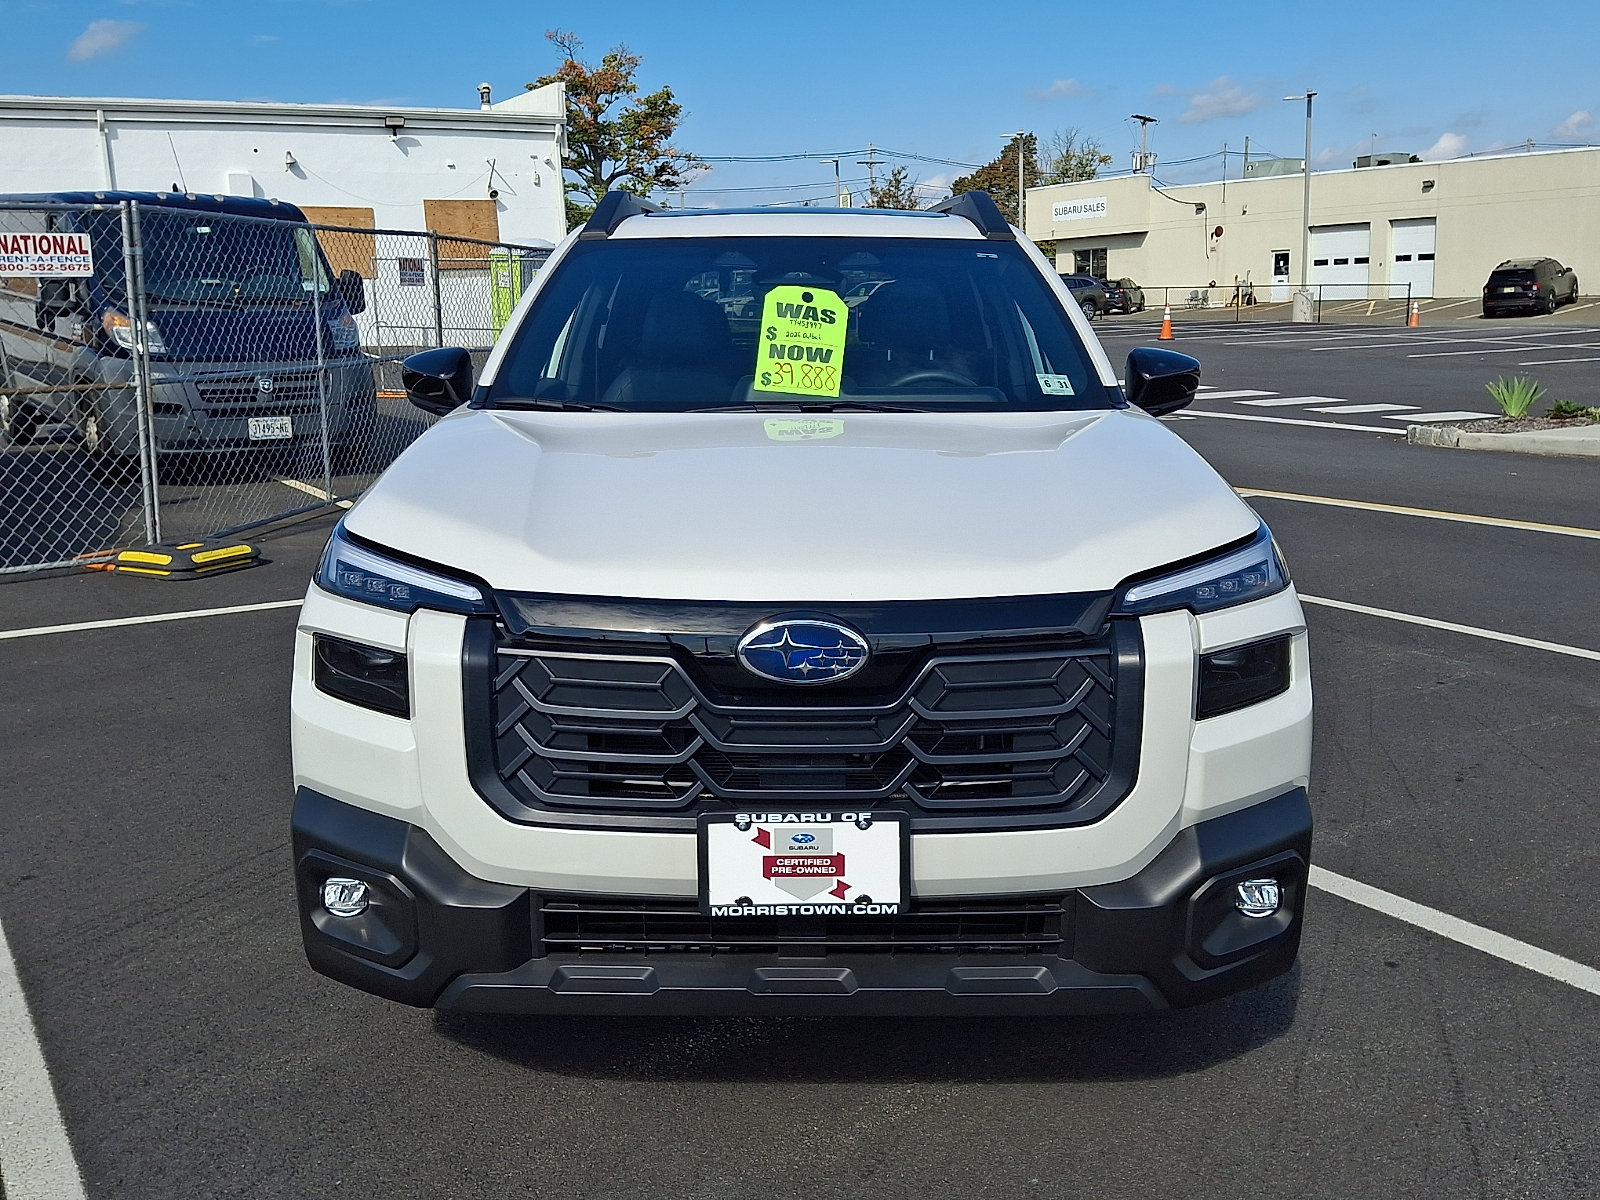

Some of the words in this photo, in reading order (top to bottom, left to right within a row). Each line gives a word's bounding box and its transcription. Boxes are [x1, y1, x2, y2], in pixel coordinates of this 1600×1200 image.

[1054, 205, 1082, 216] SUBARU
[1083, 202, 1106, 213] SALES
[0, 235, 89, 255] NATIONAL
[776, 302, 836, 324] WAS
[768, 343, 833, 363] NOW
[1044, 380, 1051, 388] 6
[1057, 380, 1069, 388] 31
[735, 813, 831, 823] SUBARU
[841, 813, 872, 822] OF
[776, 858, 831, 866] CERTIFIED
[771, 866, 836, 874] PRE-OWNED
[711, 904, 898, 916] MORRISTOWN.COM
